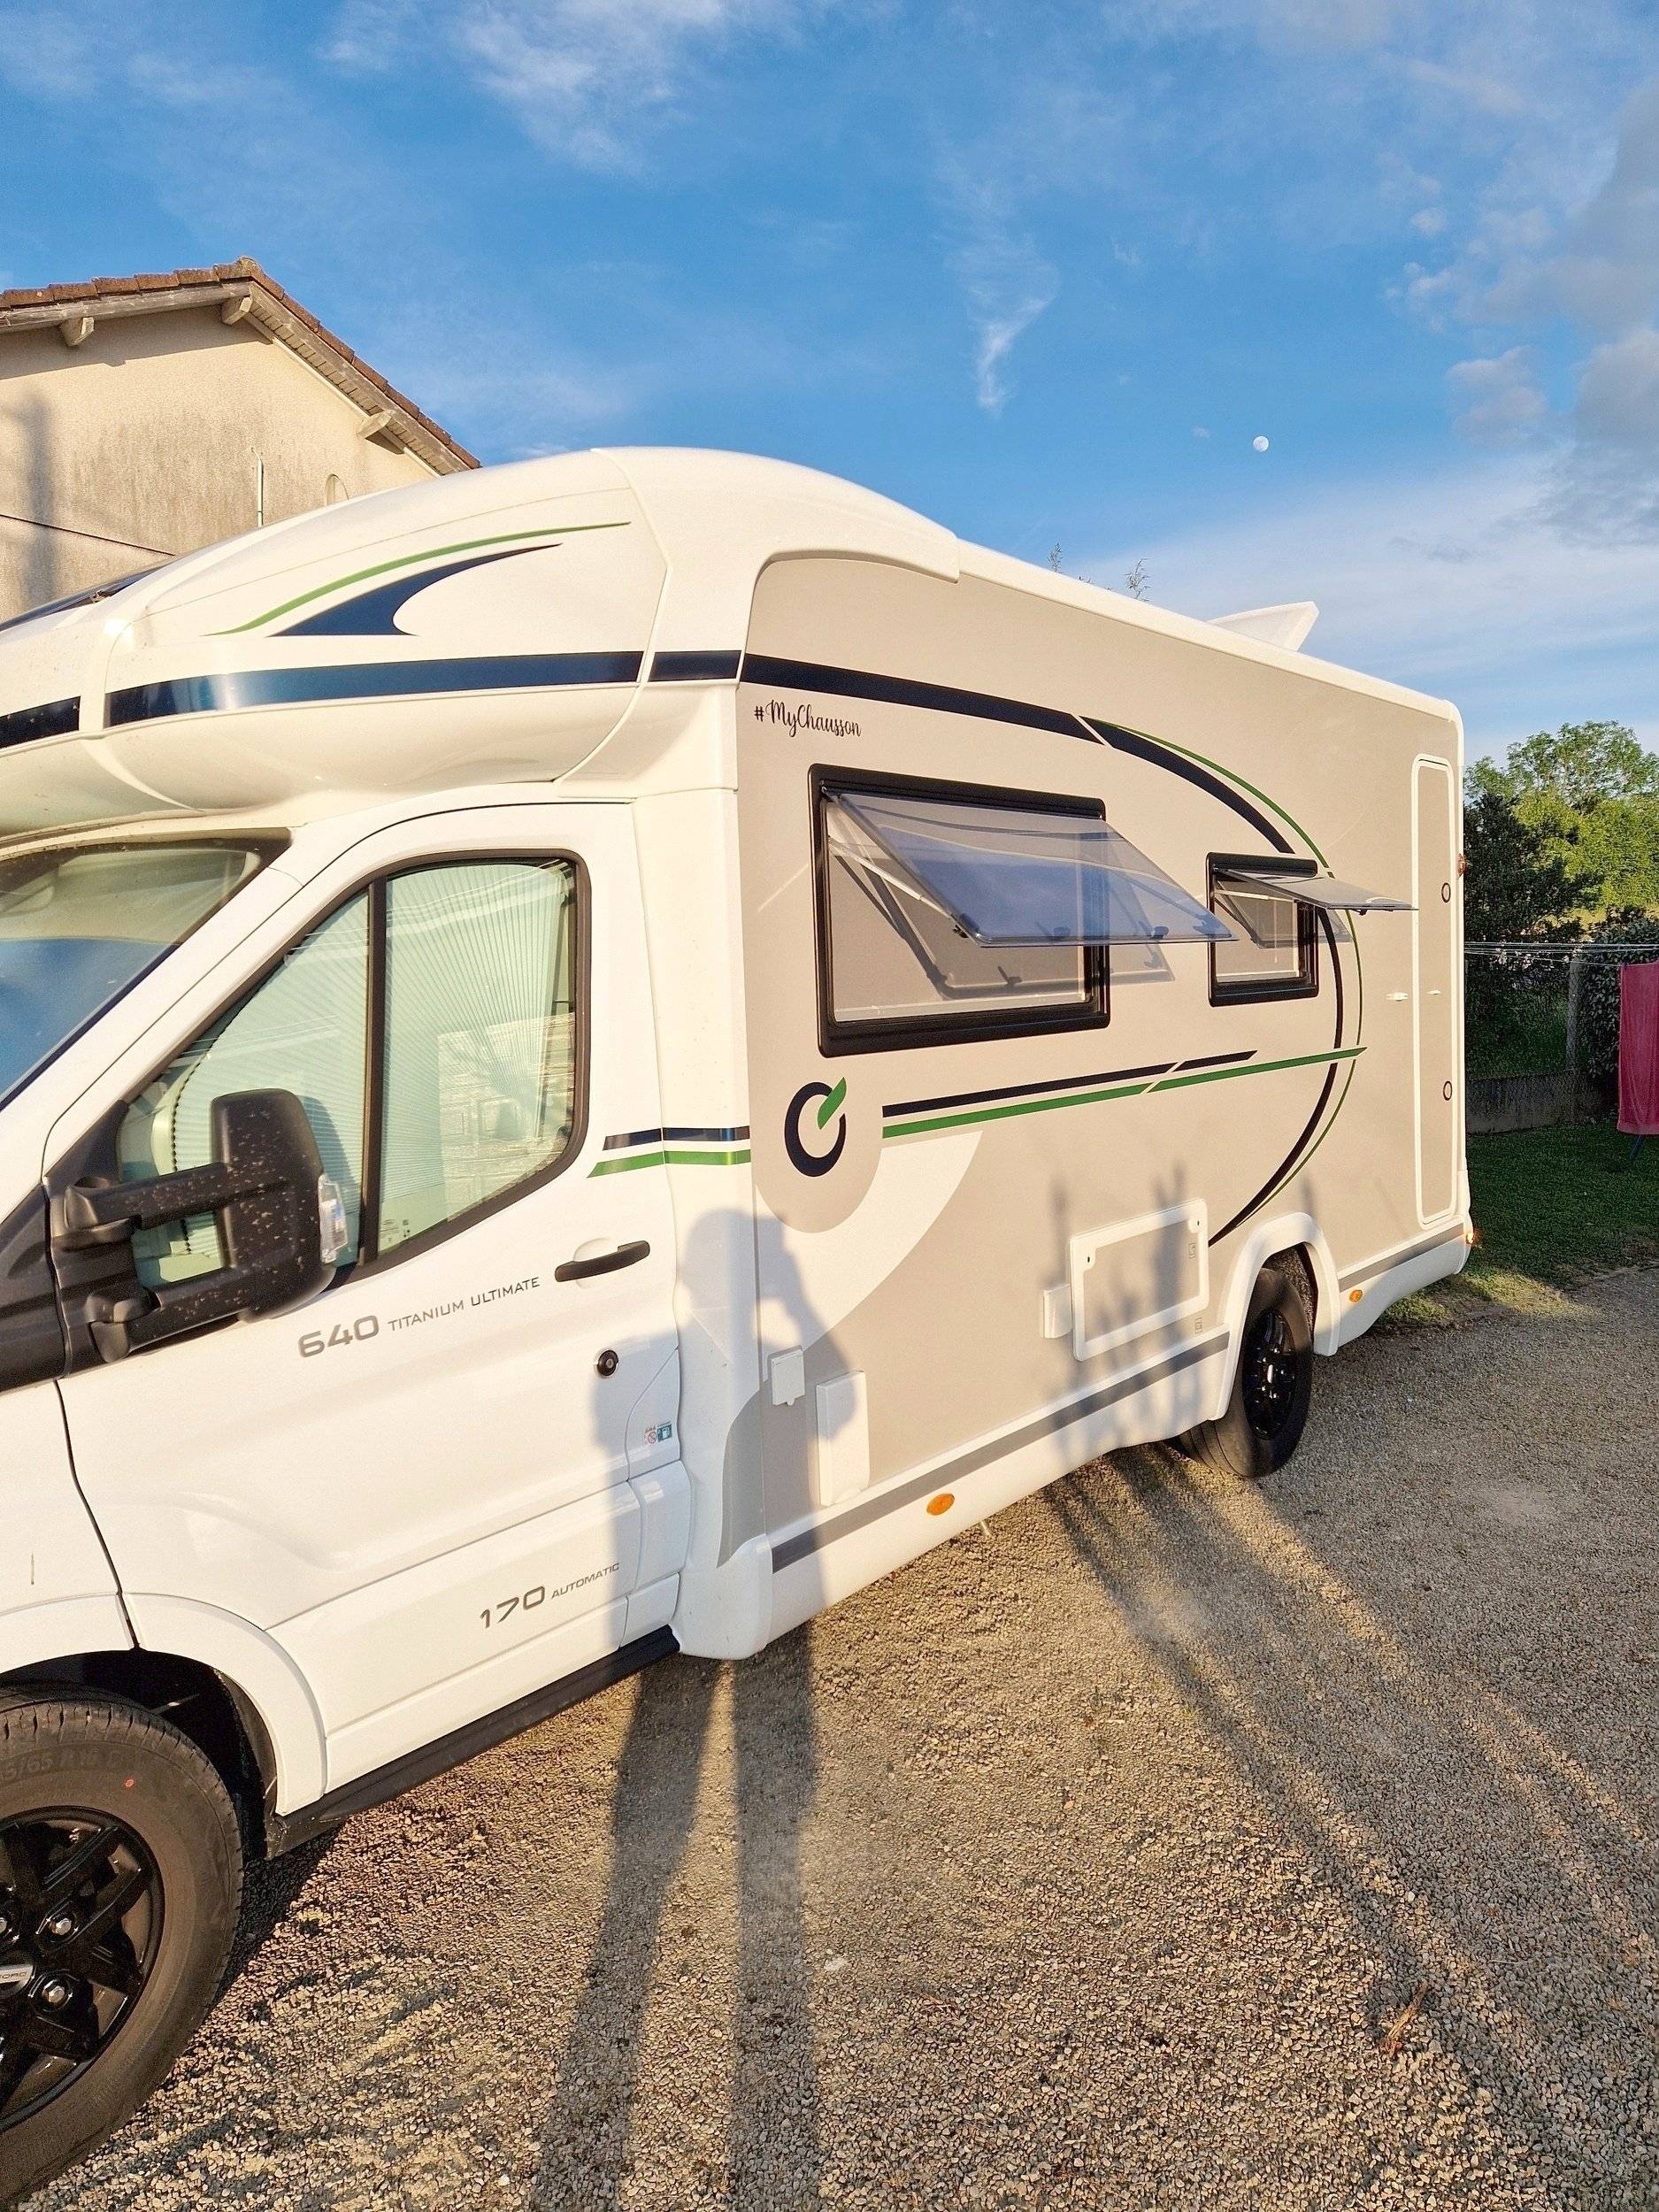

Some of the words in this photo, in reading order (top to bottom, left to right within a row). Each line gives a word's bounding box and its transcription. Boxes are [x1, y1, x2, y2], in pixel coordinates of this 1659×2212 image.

[754, 699, 862, 737] #MyChausson
[297, 1315, 380, 1358] 640
[388, 1300, 465, 1331] TITANIUM
[471, 1277, 540, 1306] ULTIMATE
[480, 1586, 546, 1629] 170
[551, 1563, 620, 1600] AUTOMATIC
